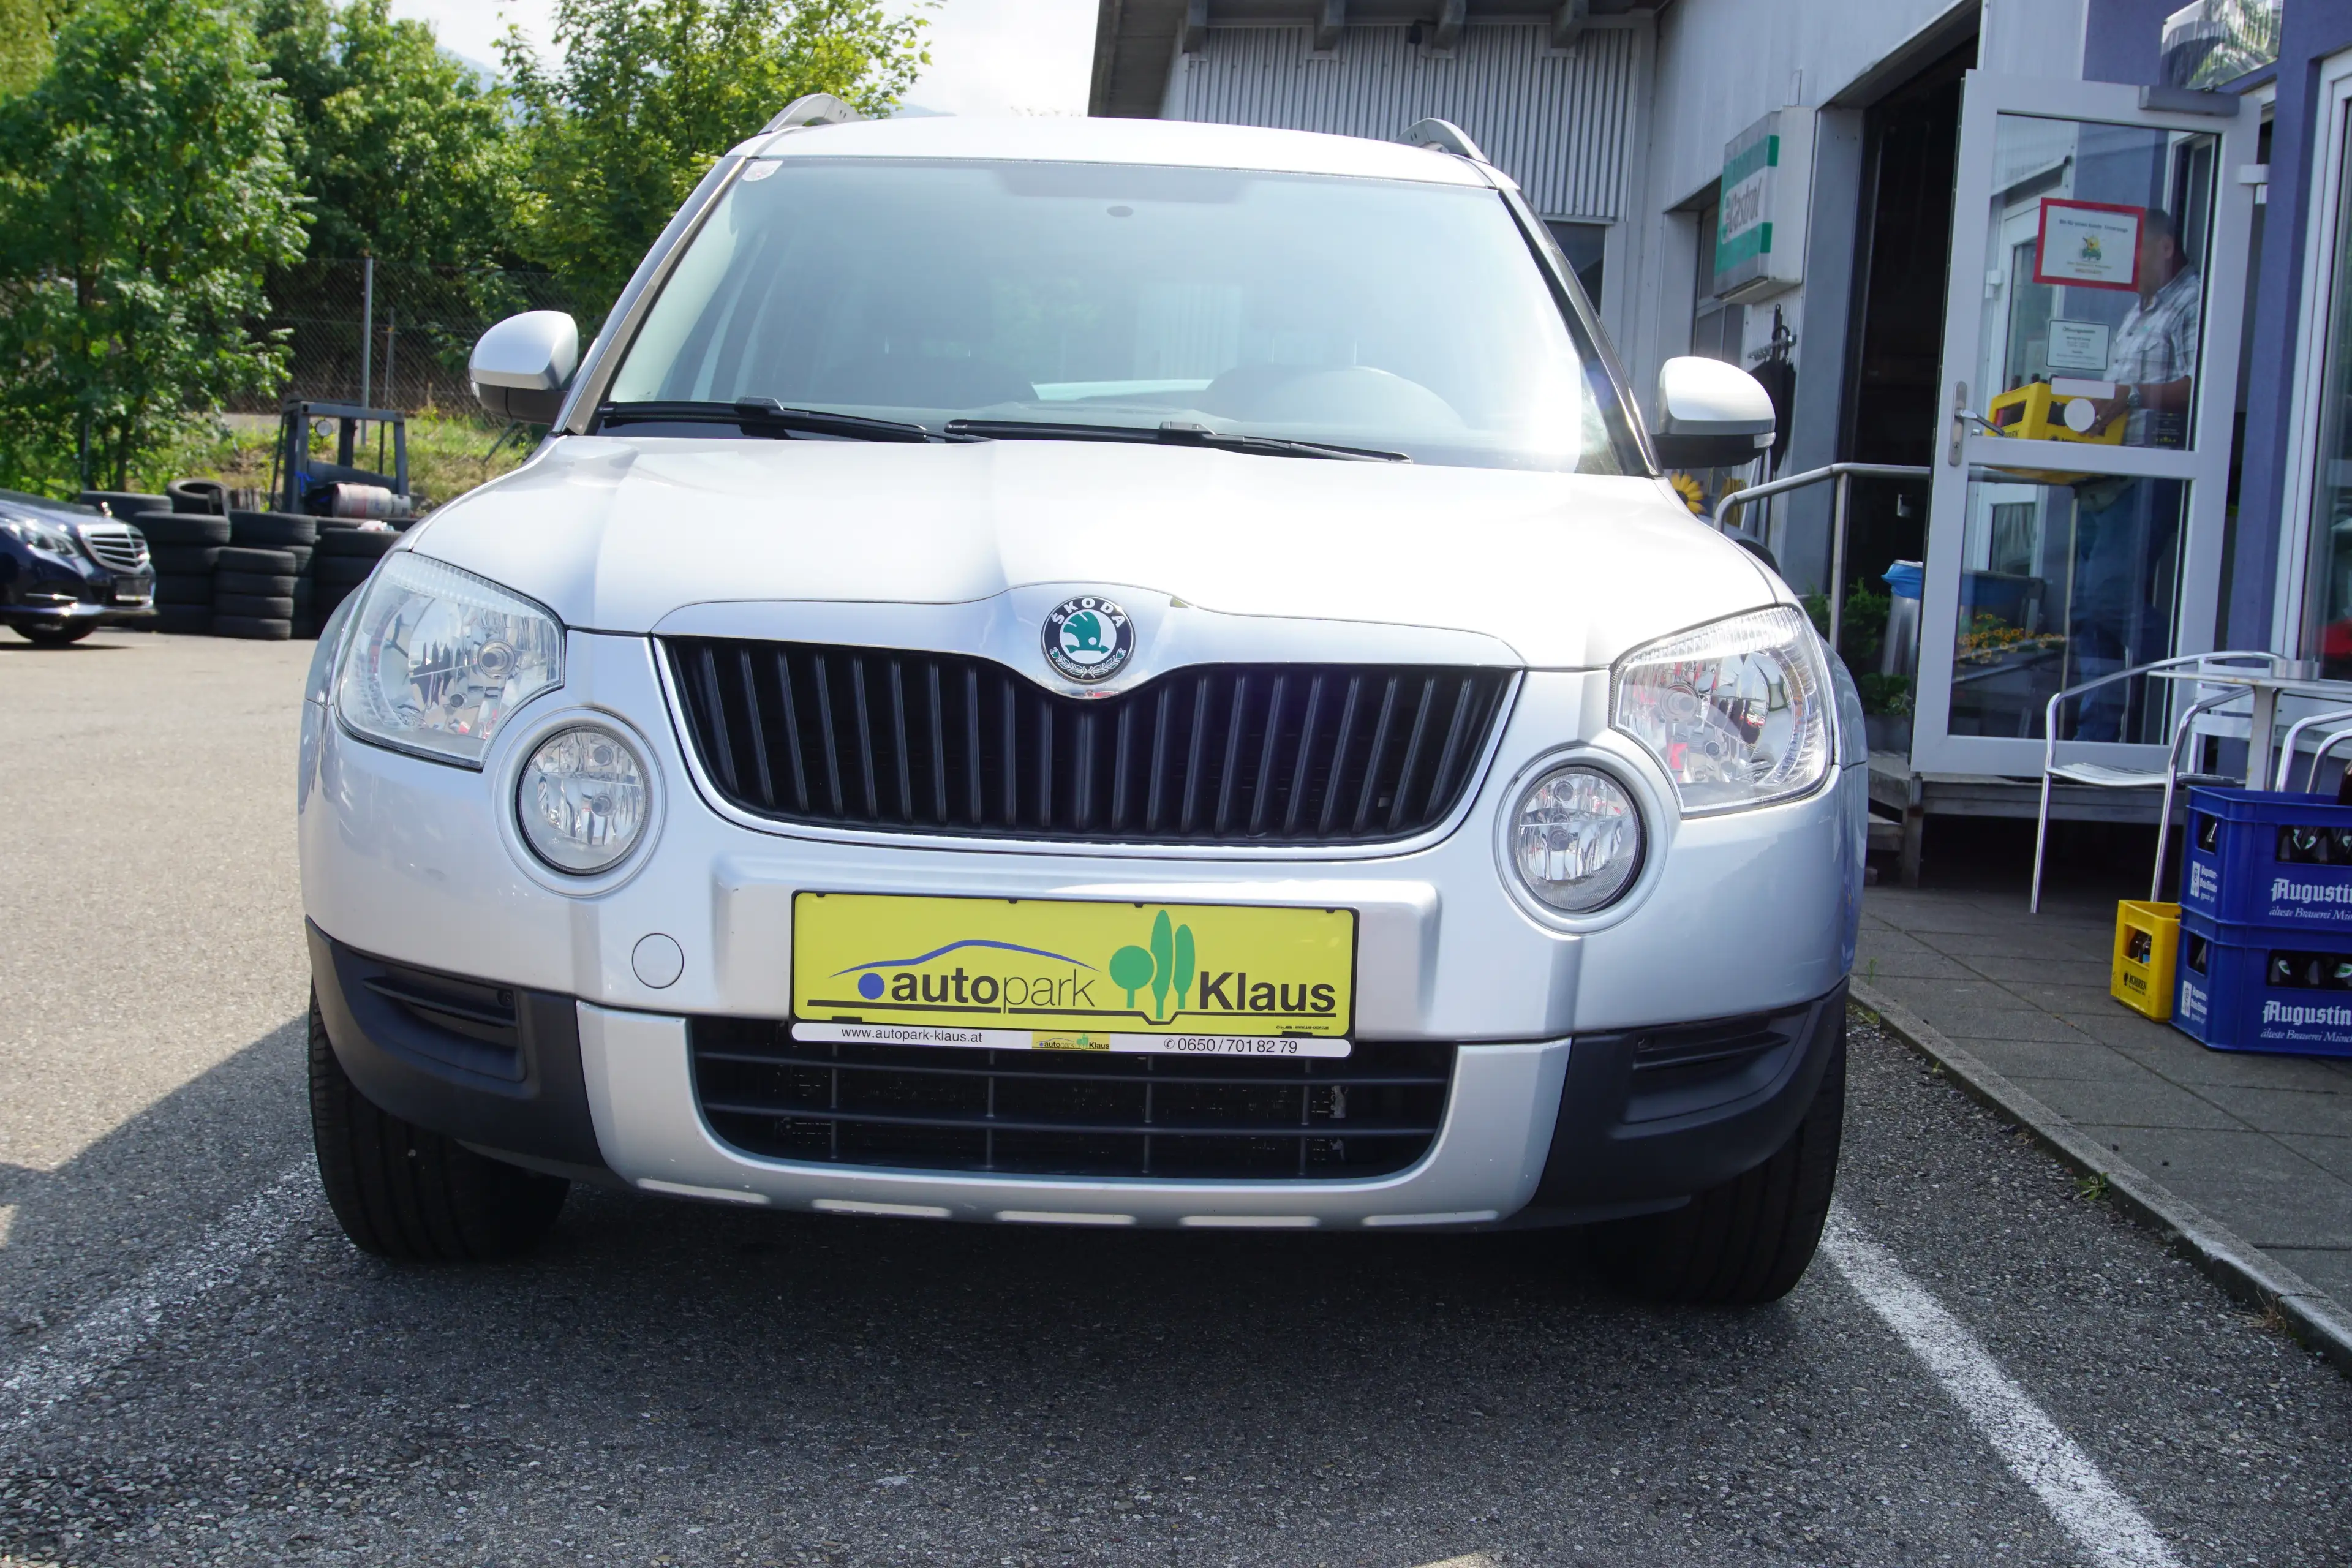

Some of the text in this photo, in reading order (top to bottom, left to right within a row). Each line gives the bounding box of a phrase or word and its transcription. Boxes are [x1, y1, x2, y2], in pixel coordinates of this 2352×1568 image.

[1051, 598, 1126, 628] ŠKODA
[2269, 905, 2294, 917] älteste
[2295, 907, 2331, 919] Brauerei
[891, 967, 1336, 1014] autopark Klaus
[841, 1028, 982, 1042] www.autopark-klaus.at
[2260, 1028, 2285, 1039] älteste
[2286, 1029, 2323, 1041] Brauerei
